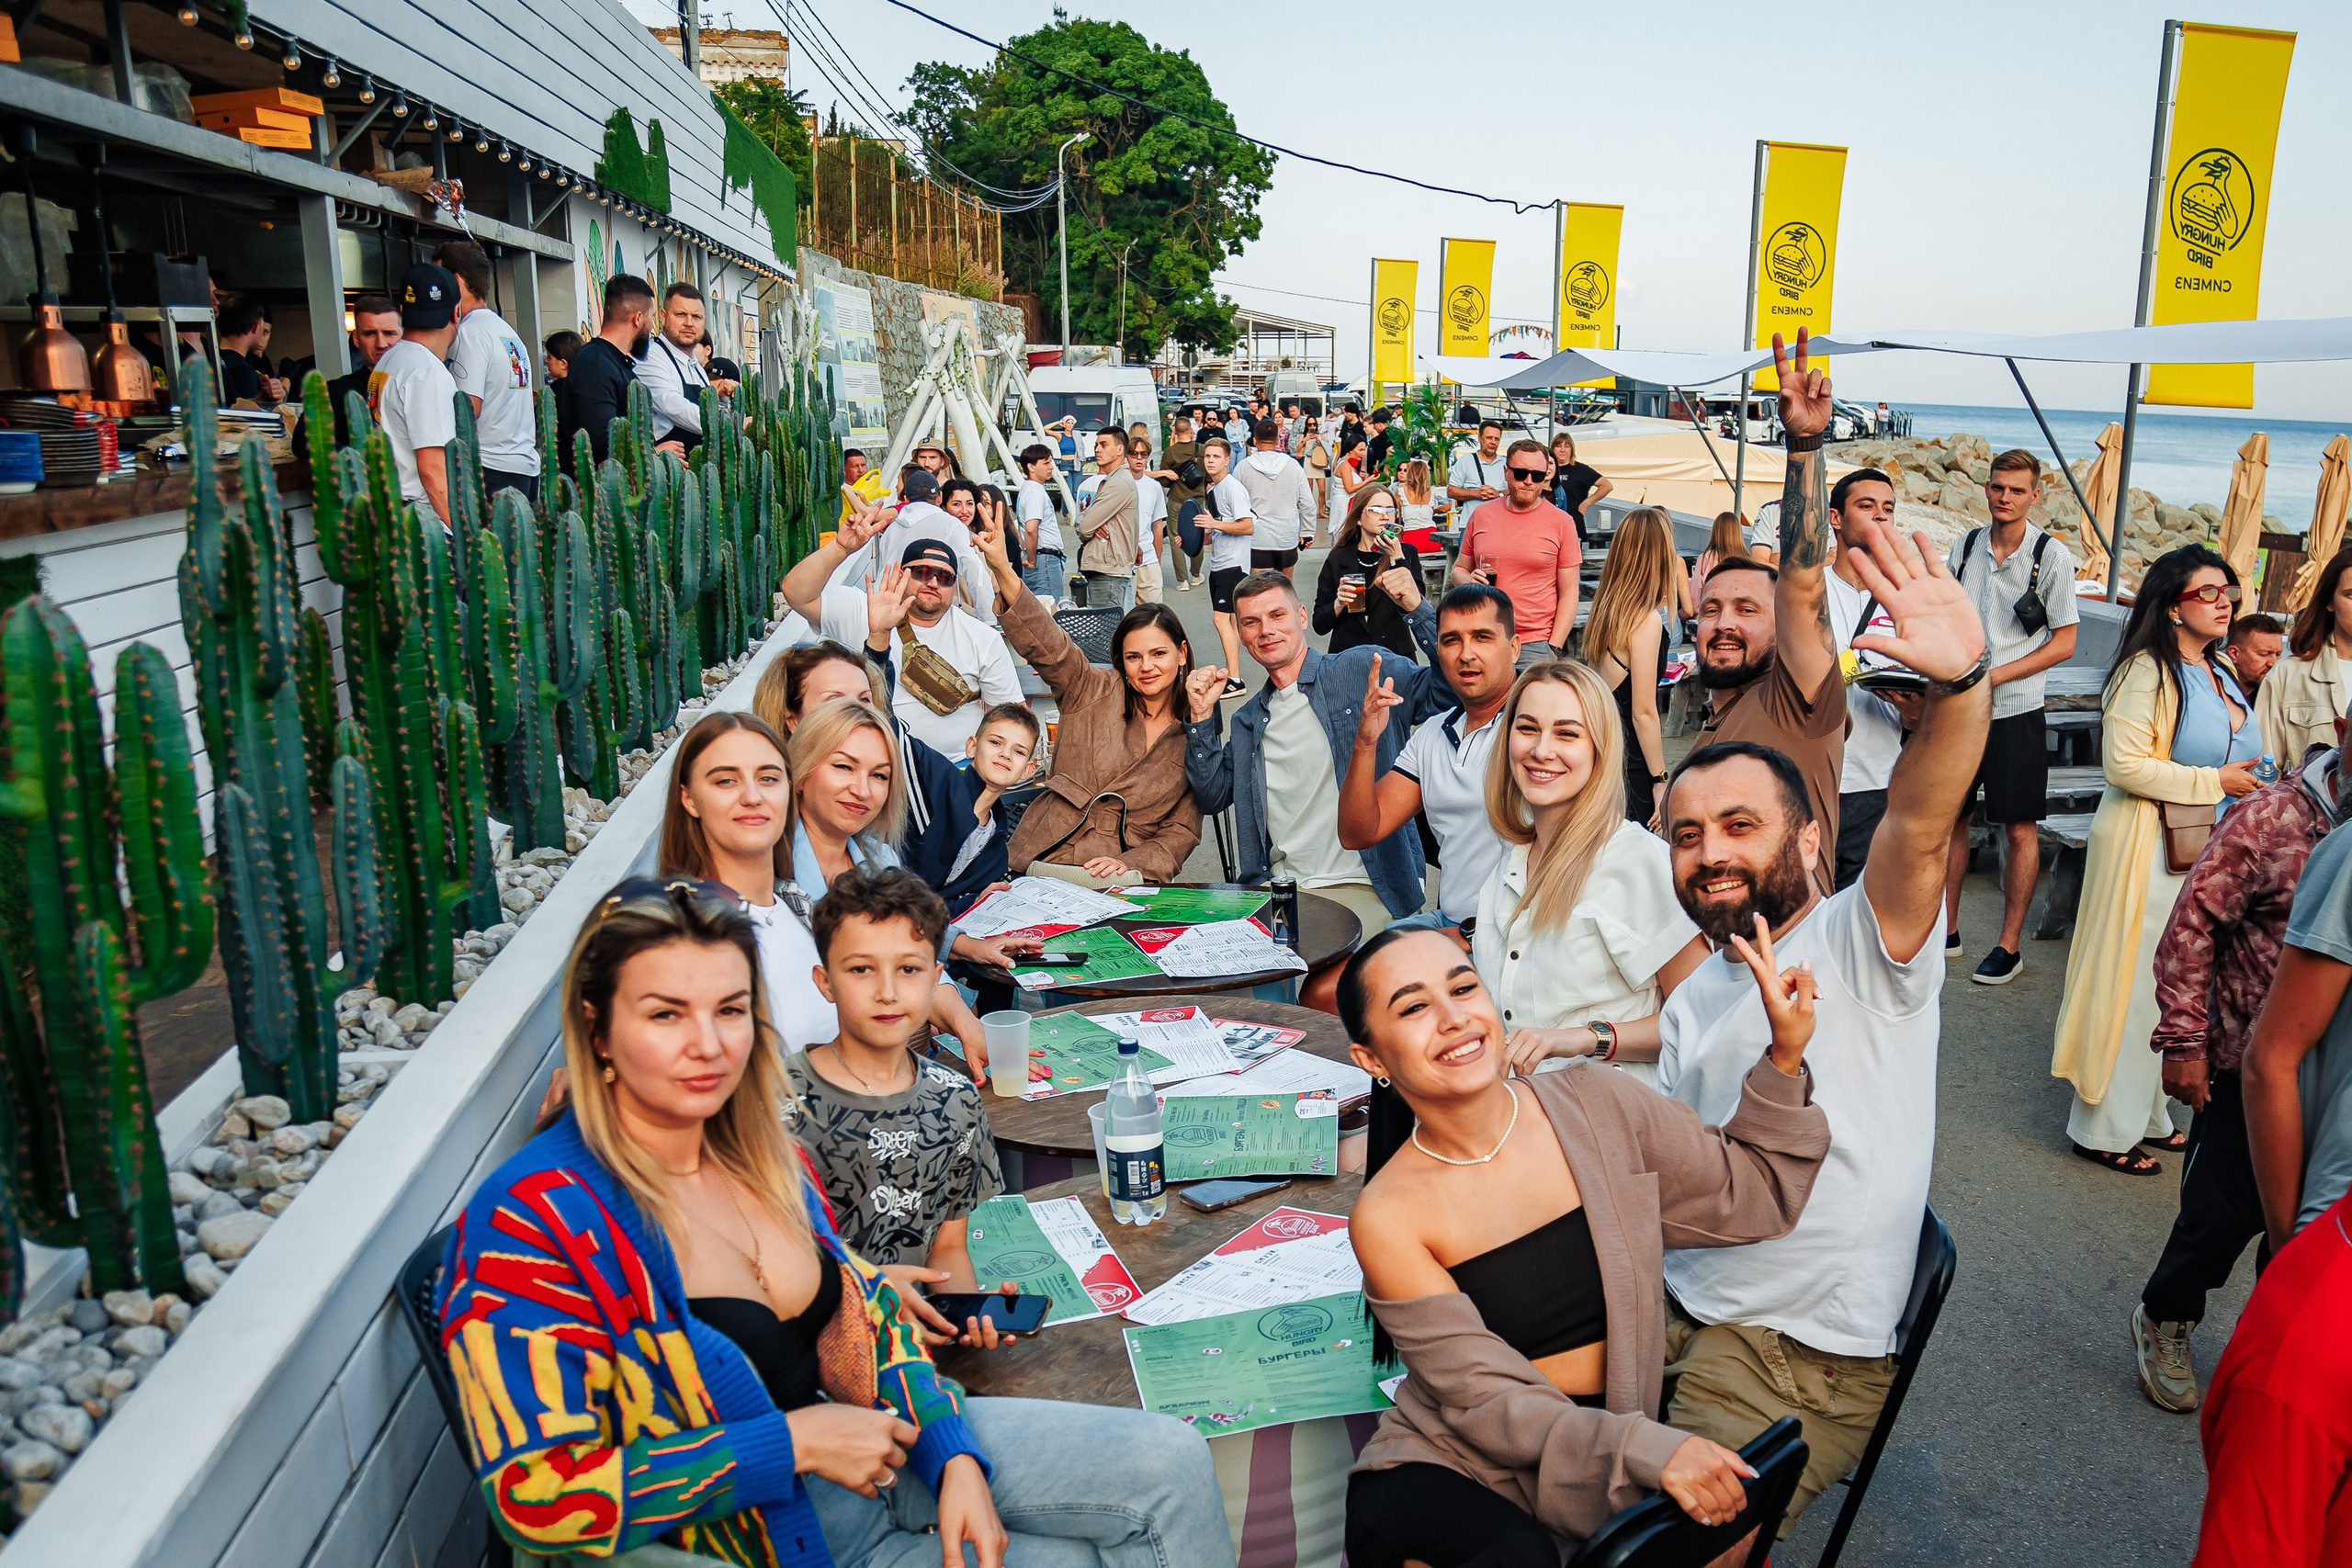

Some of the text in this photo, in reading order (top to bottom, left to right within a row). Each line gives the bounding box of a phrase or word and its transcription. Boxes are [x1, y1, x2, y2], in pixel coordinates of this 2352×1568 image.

[1281, 1325, 1324, 1342] HUNGRY
[1292, 1337, 1317, 1348] BIRD
[1257, 1347, 1327, 1365] БУРГЕРЫ
